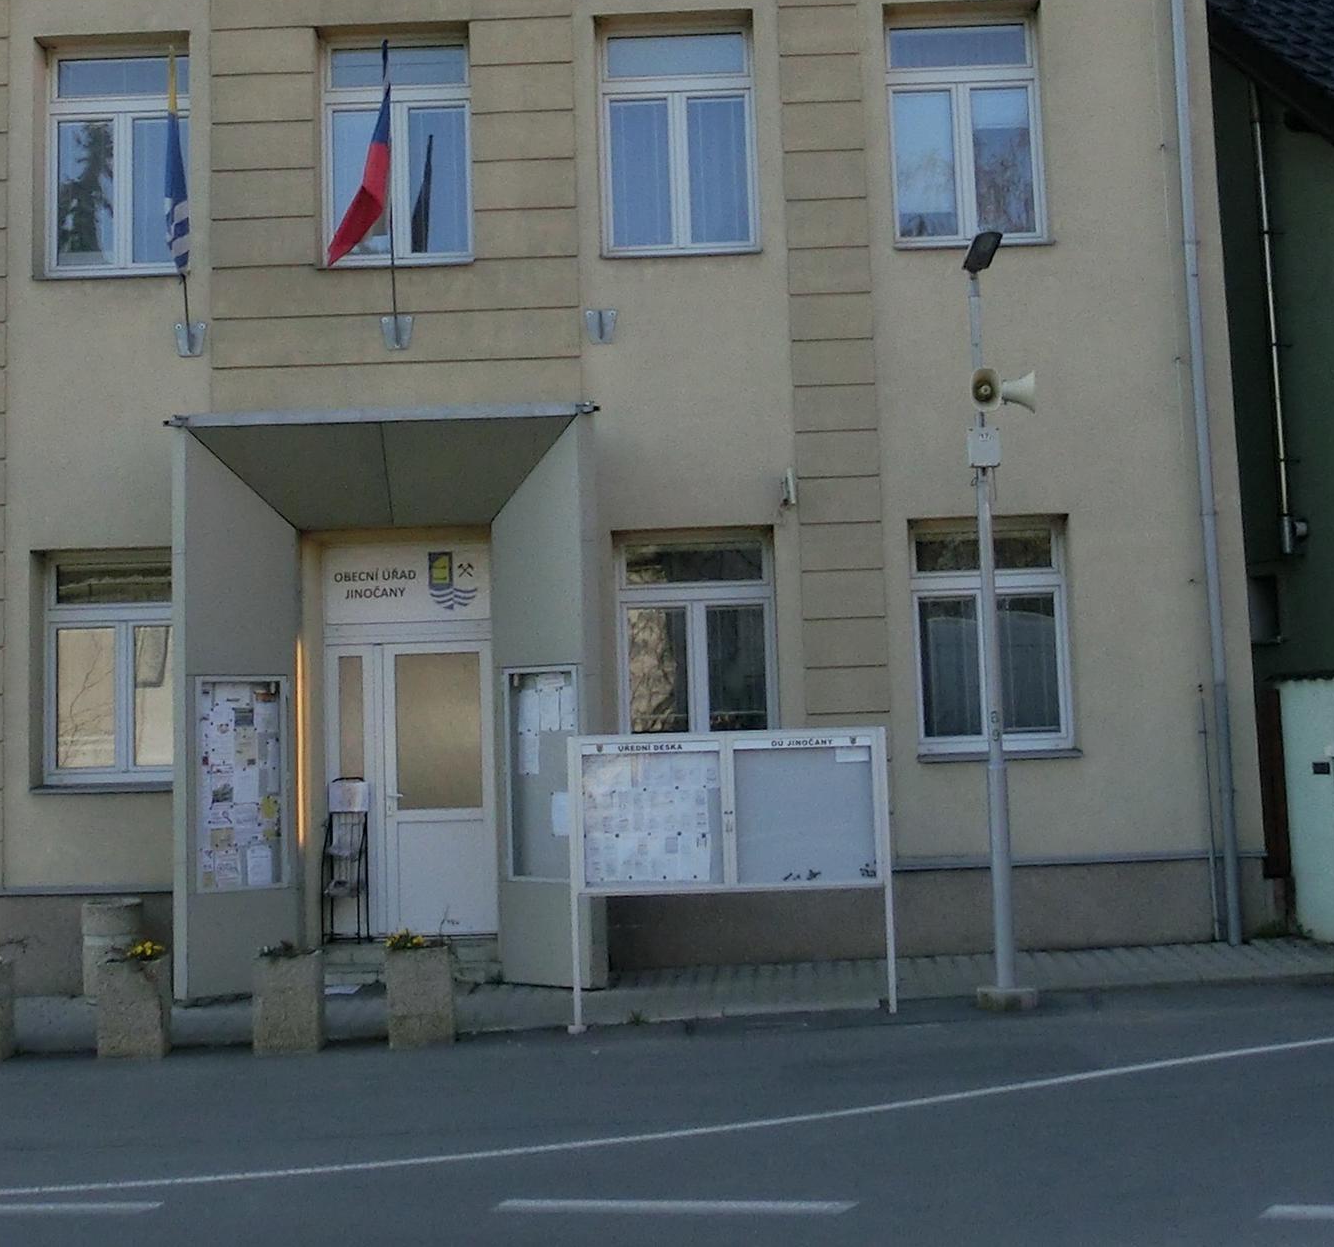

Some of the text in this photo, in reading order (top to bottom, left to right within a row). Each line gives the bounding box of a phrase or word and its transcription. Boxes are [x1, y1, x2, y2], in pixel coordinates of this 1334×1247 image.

[334, 567, 416, 583] OBECNÍ ÚŘAD
[345, 586, 405, 600] JINOČANY
[653, 743, 683, 751] DESKA
[787, 738, 833, 747] JINOČANY
